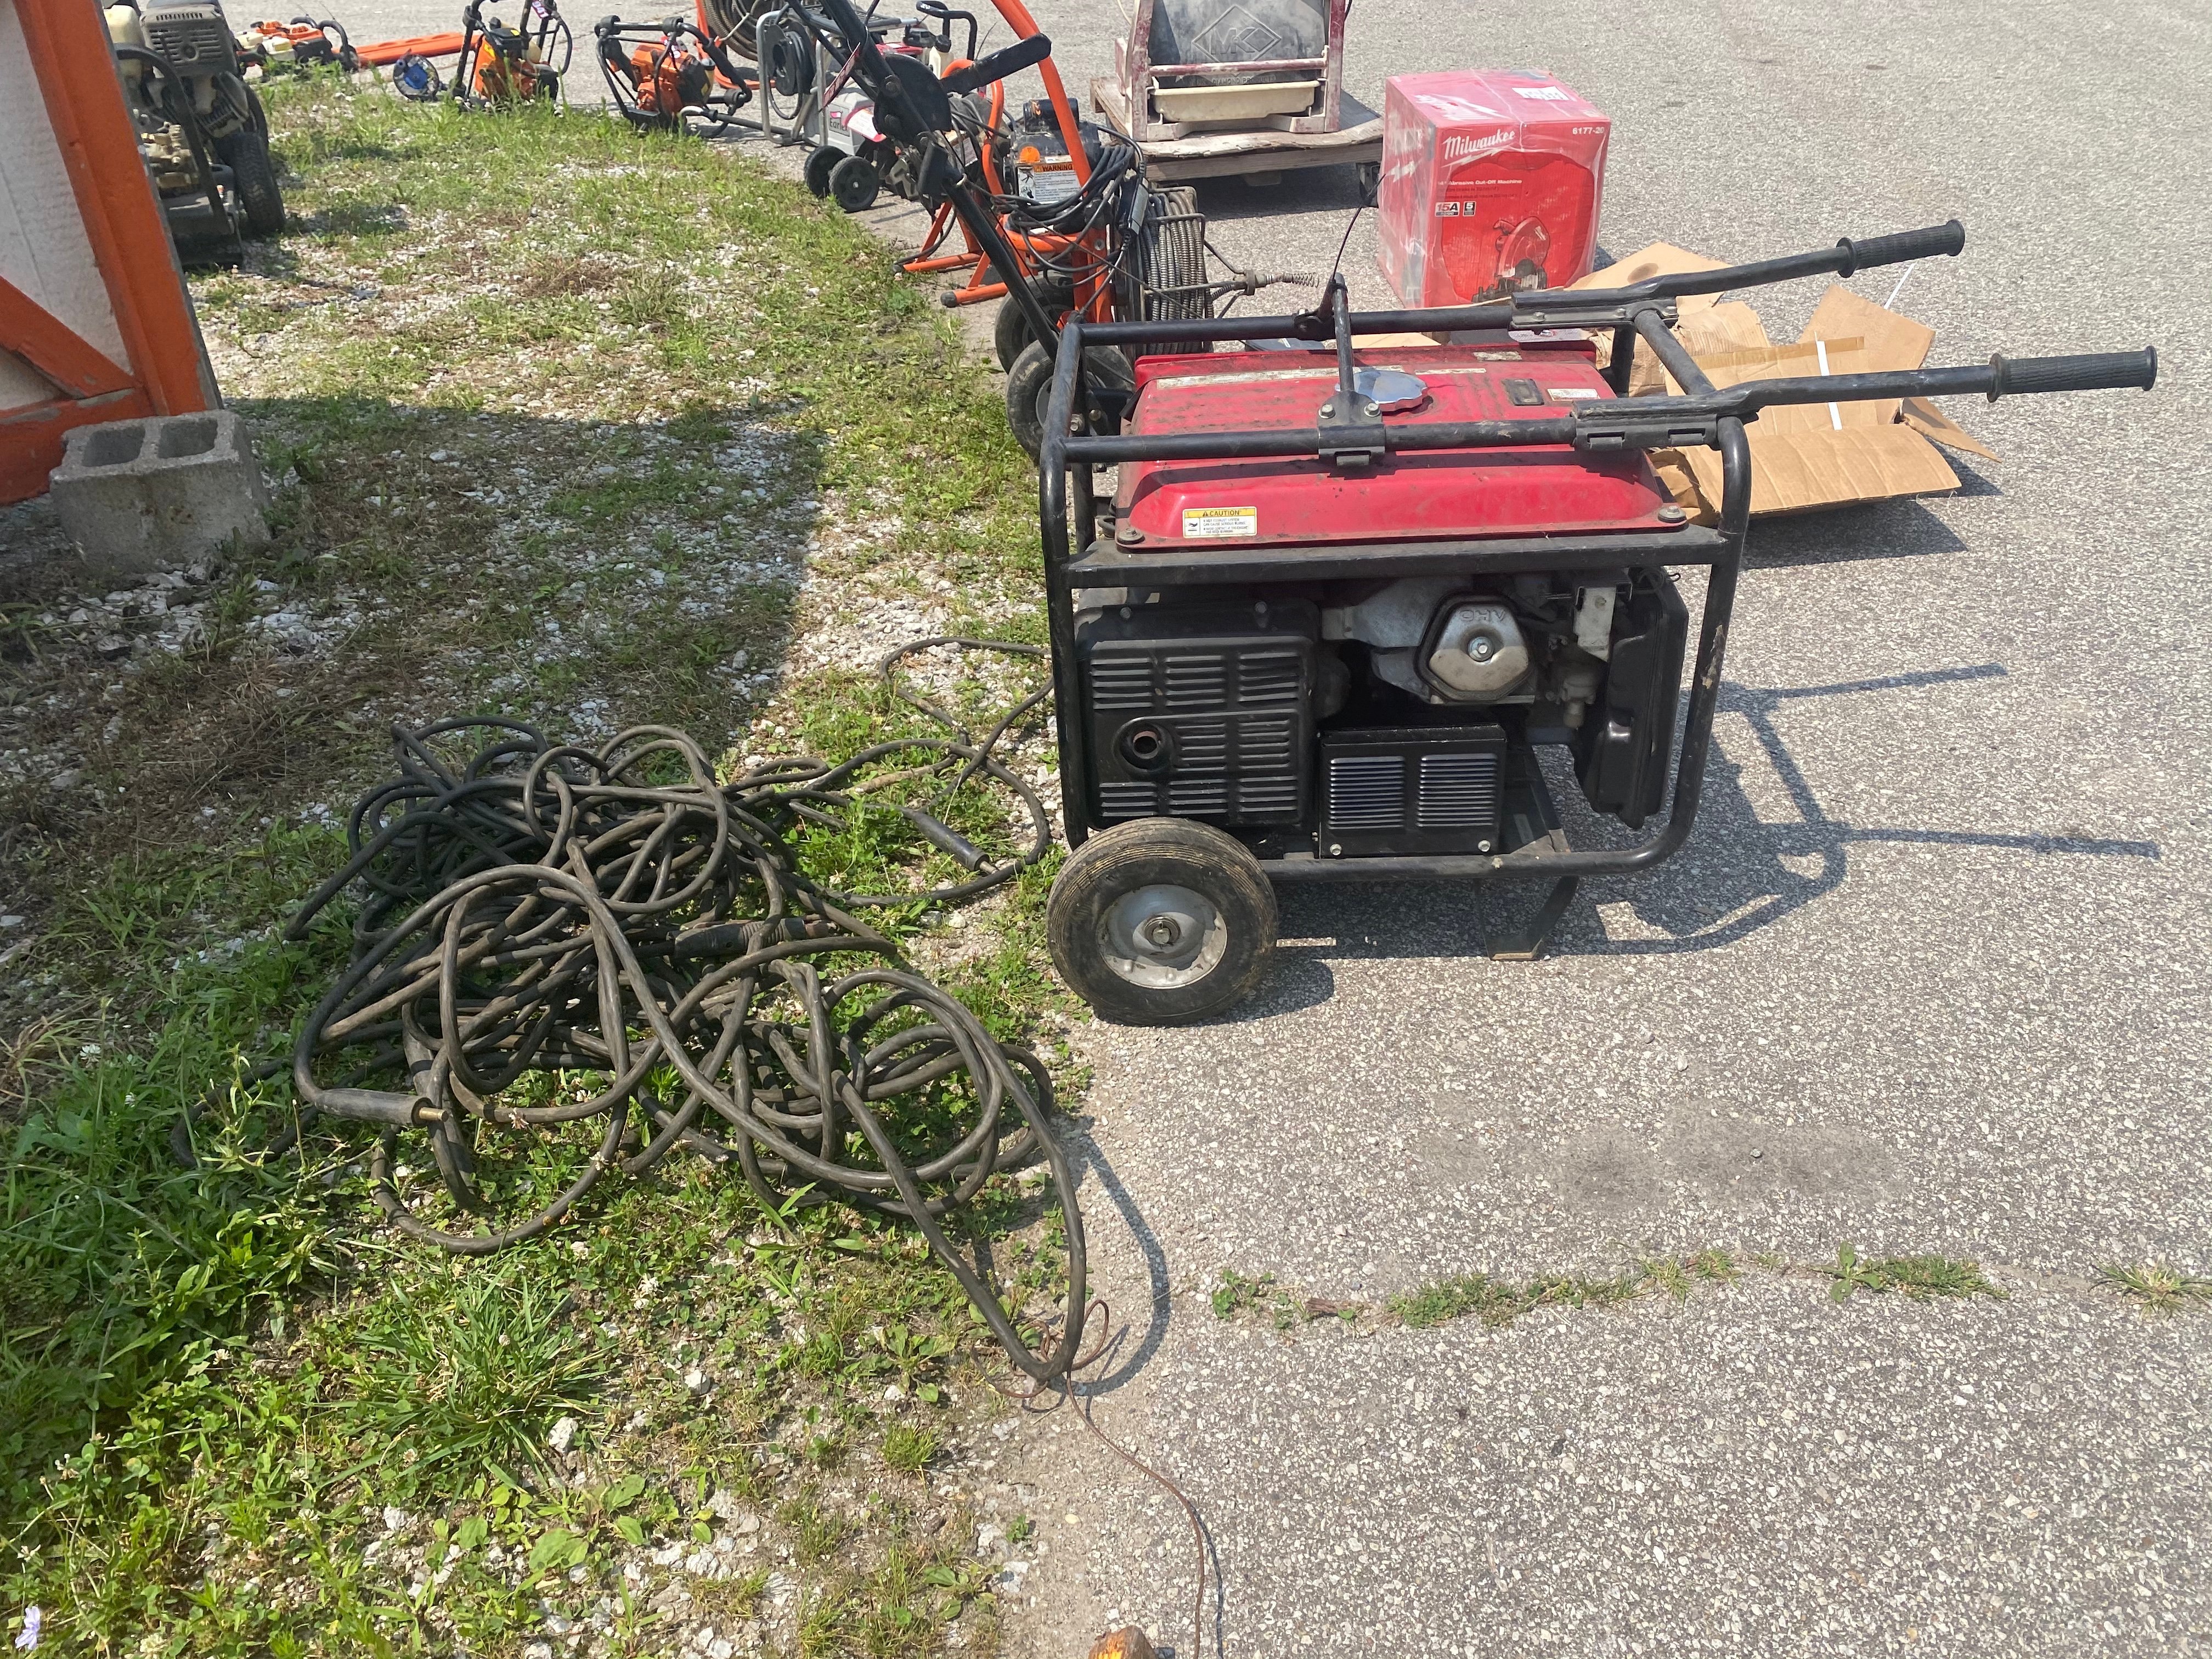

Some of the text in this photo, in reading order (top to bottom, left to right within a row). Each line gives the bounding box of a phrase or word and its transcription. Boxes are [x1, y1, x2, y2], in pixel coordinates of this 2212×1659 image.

[1442, 129, 1515, 160] Milwaukee
[1437, 202, 1458, 211] 15A
[1459, 608, 1505, 623] OHV
